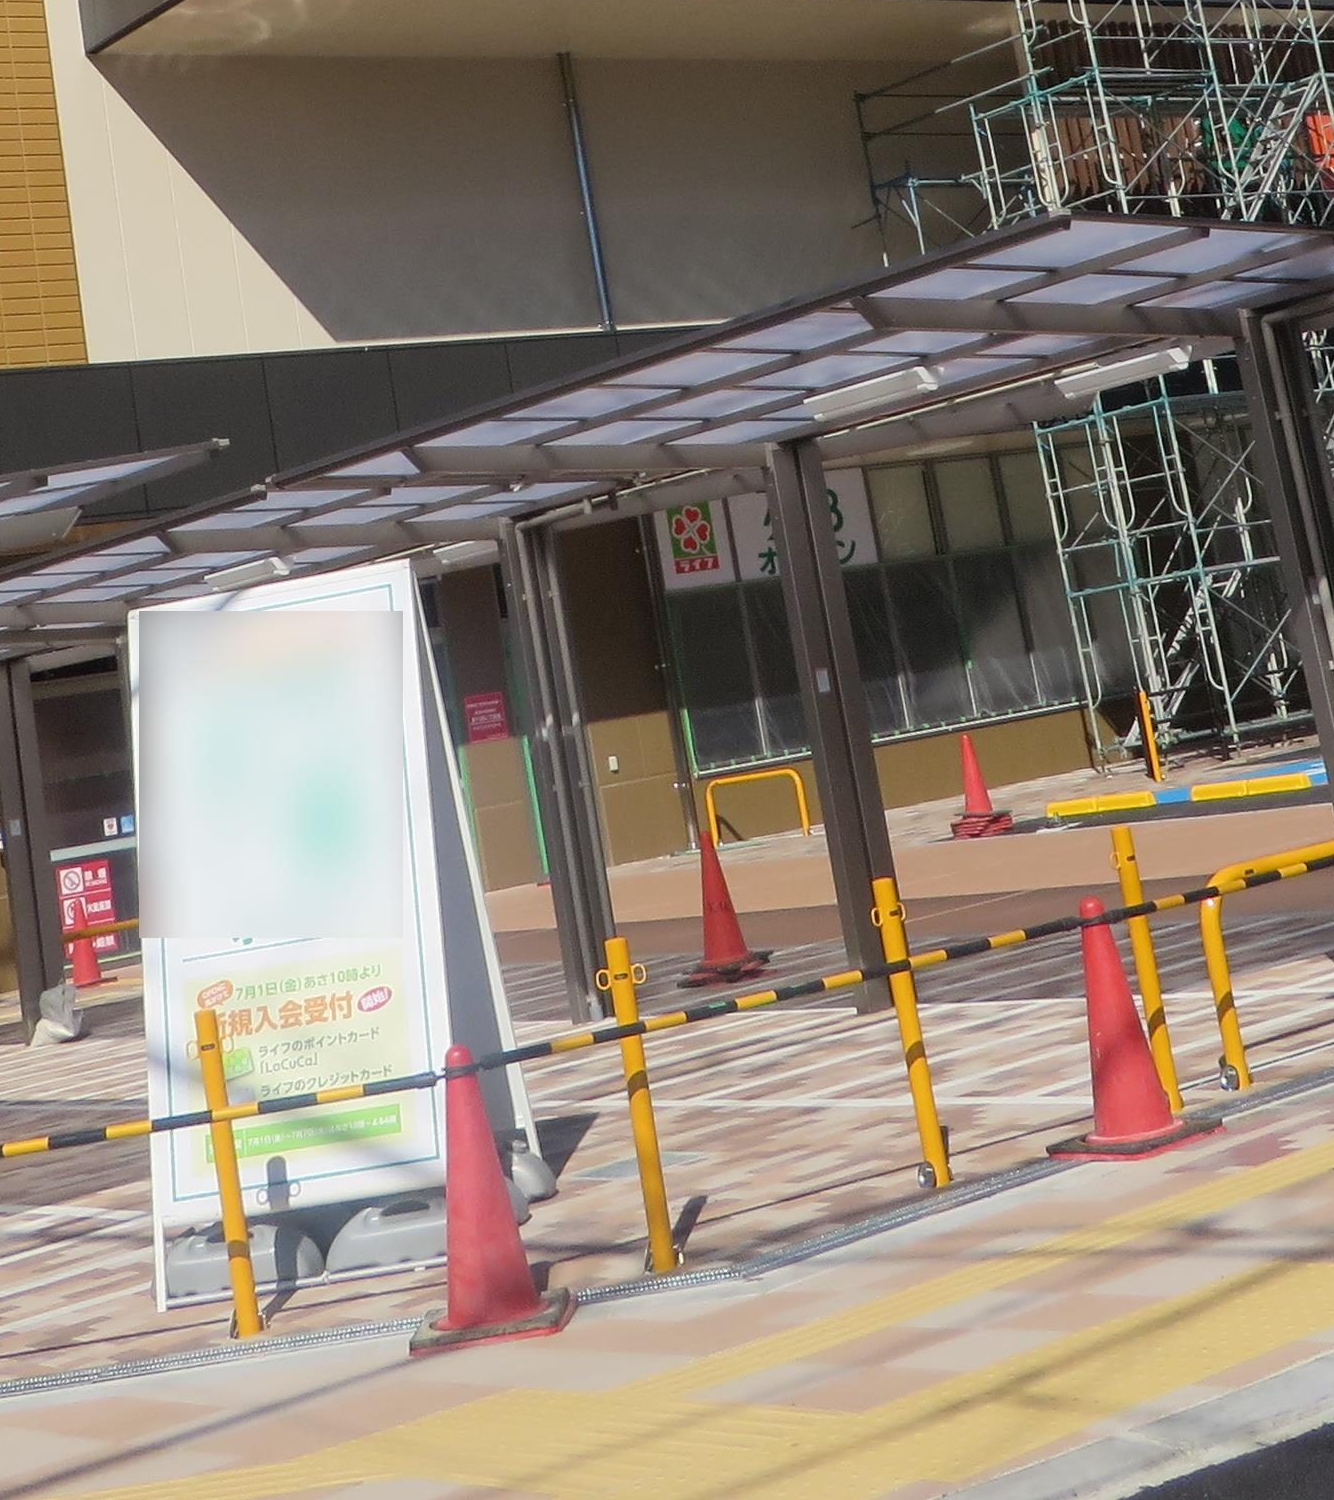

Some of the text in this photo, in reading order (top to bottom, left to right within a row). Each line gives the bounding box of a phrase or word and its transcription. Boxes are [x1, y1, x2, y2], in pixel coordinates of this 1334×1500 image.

[679, 557, 716, 572] ライフ
[259, 1026, 381, 1058] ライフのポイントカード
